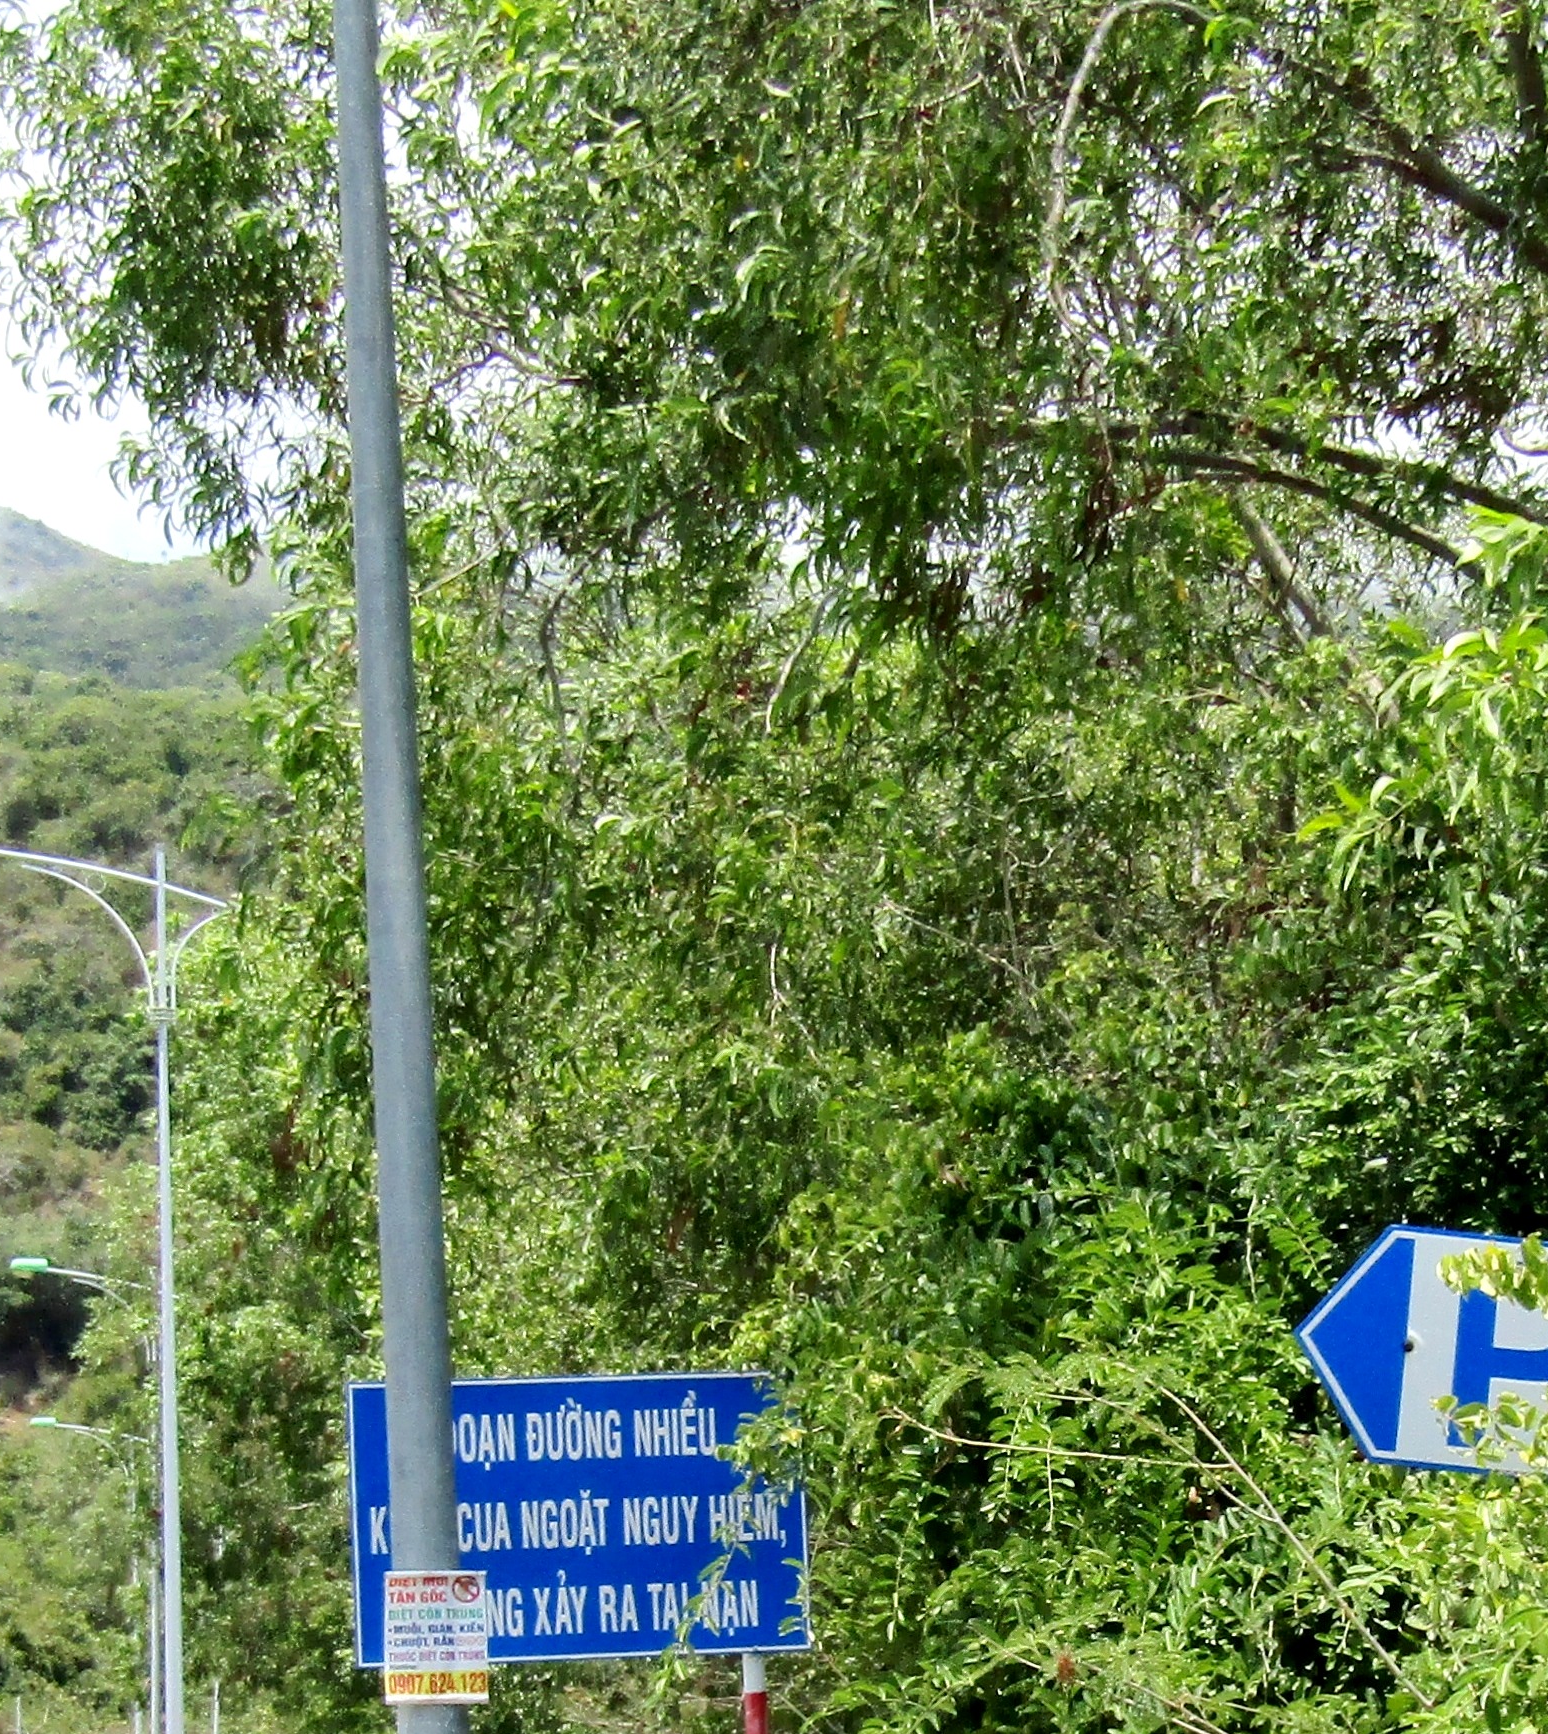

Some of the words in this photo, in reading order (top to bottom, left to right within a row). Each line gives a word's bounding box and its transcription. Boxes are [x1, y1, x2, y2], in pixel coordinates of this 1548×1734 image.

[452, 1413, 516, 1471] OẠN
[526, 1397, 621, 1462] ĐƯỜNG
[633, 1389, 716, 1457] NHIỀU
[457, 1502, 512, 1552] CUA
[521, 1489, 609, 1555] NGOẶT
[622, 1496, 698, 1546] NGUY
[532, 1570, 587, 1636] XẢY
[599, 1585, 639, 1633] RA
[646, 1581, 689, 1632] TAI
[701, 1580, 760, 1637] NẠN
